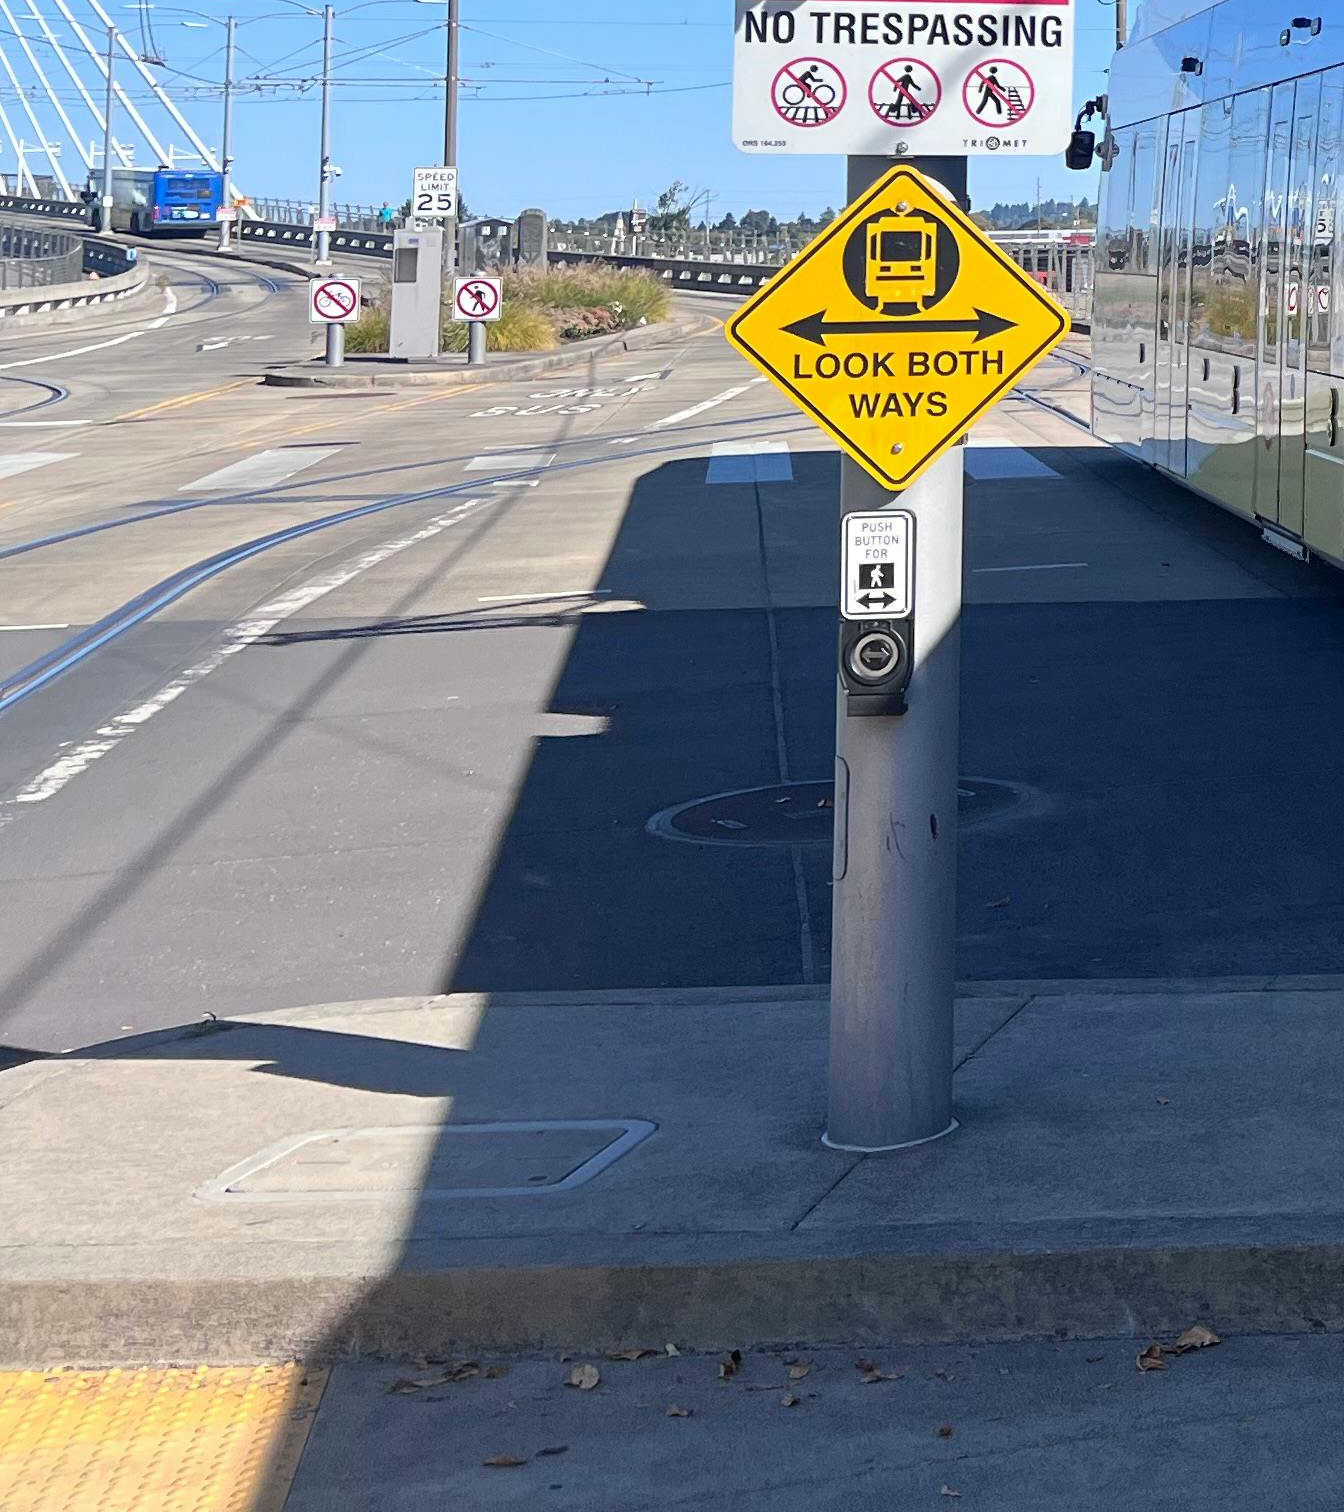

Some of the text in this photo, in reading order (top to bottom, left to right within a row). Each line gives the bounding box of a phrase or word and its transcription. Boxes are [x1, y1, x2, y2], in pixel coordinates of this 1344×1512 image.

[744, 10, 1062, 48] NO TRESPASSING
[417, 172, 455, 182] SPEED
[420, 183, 450, 192] LIMIT
[417, 193, 452, 211] 25
[793, 350, 1004, 379] LOOK BOTH
[848, 390, 948, 418] WAYS
[861, 522, 893, 533] PUSH
[854, 535, 899, 546] BUTTON
[865, 548, 888, 559] FOR
